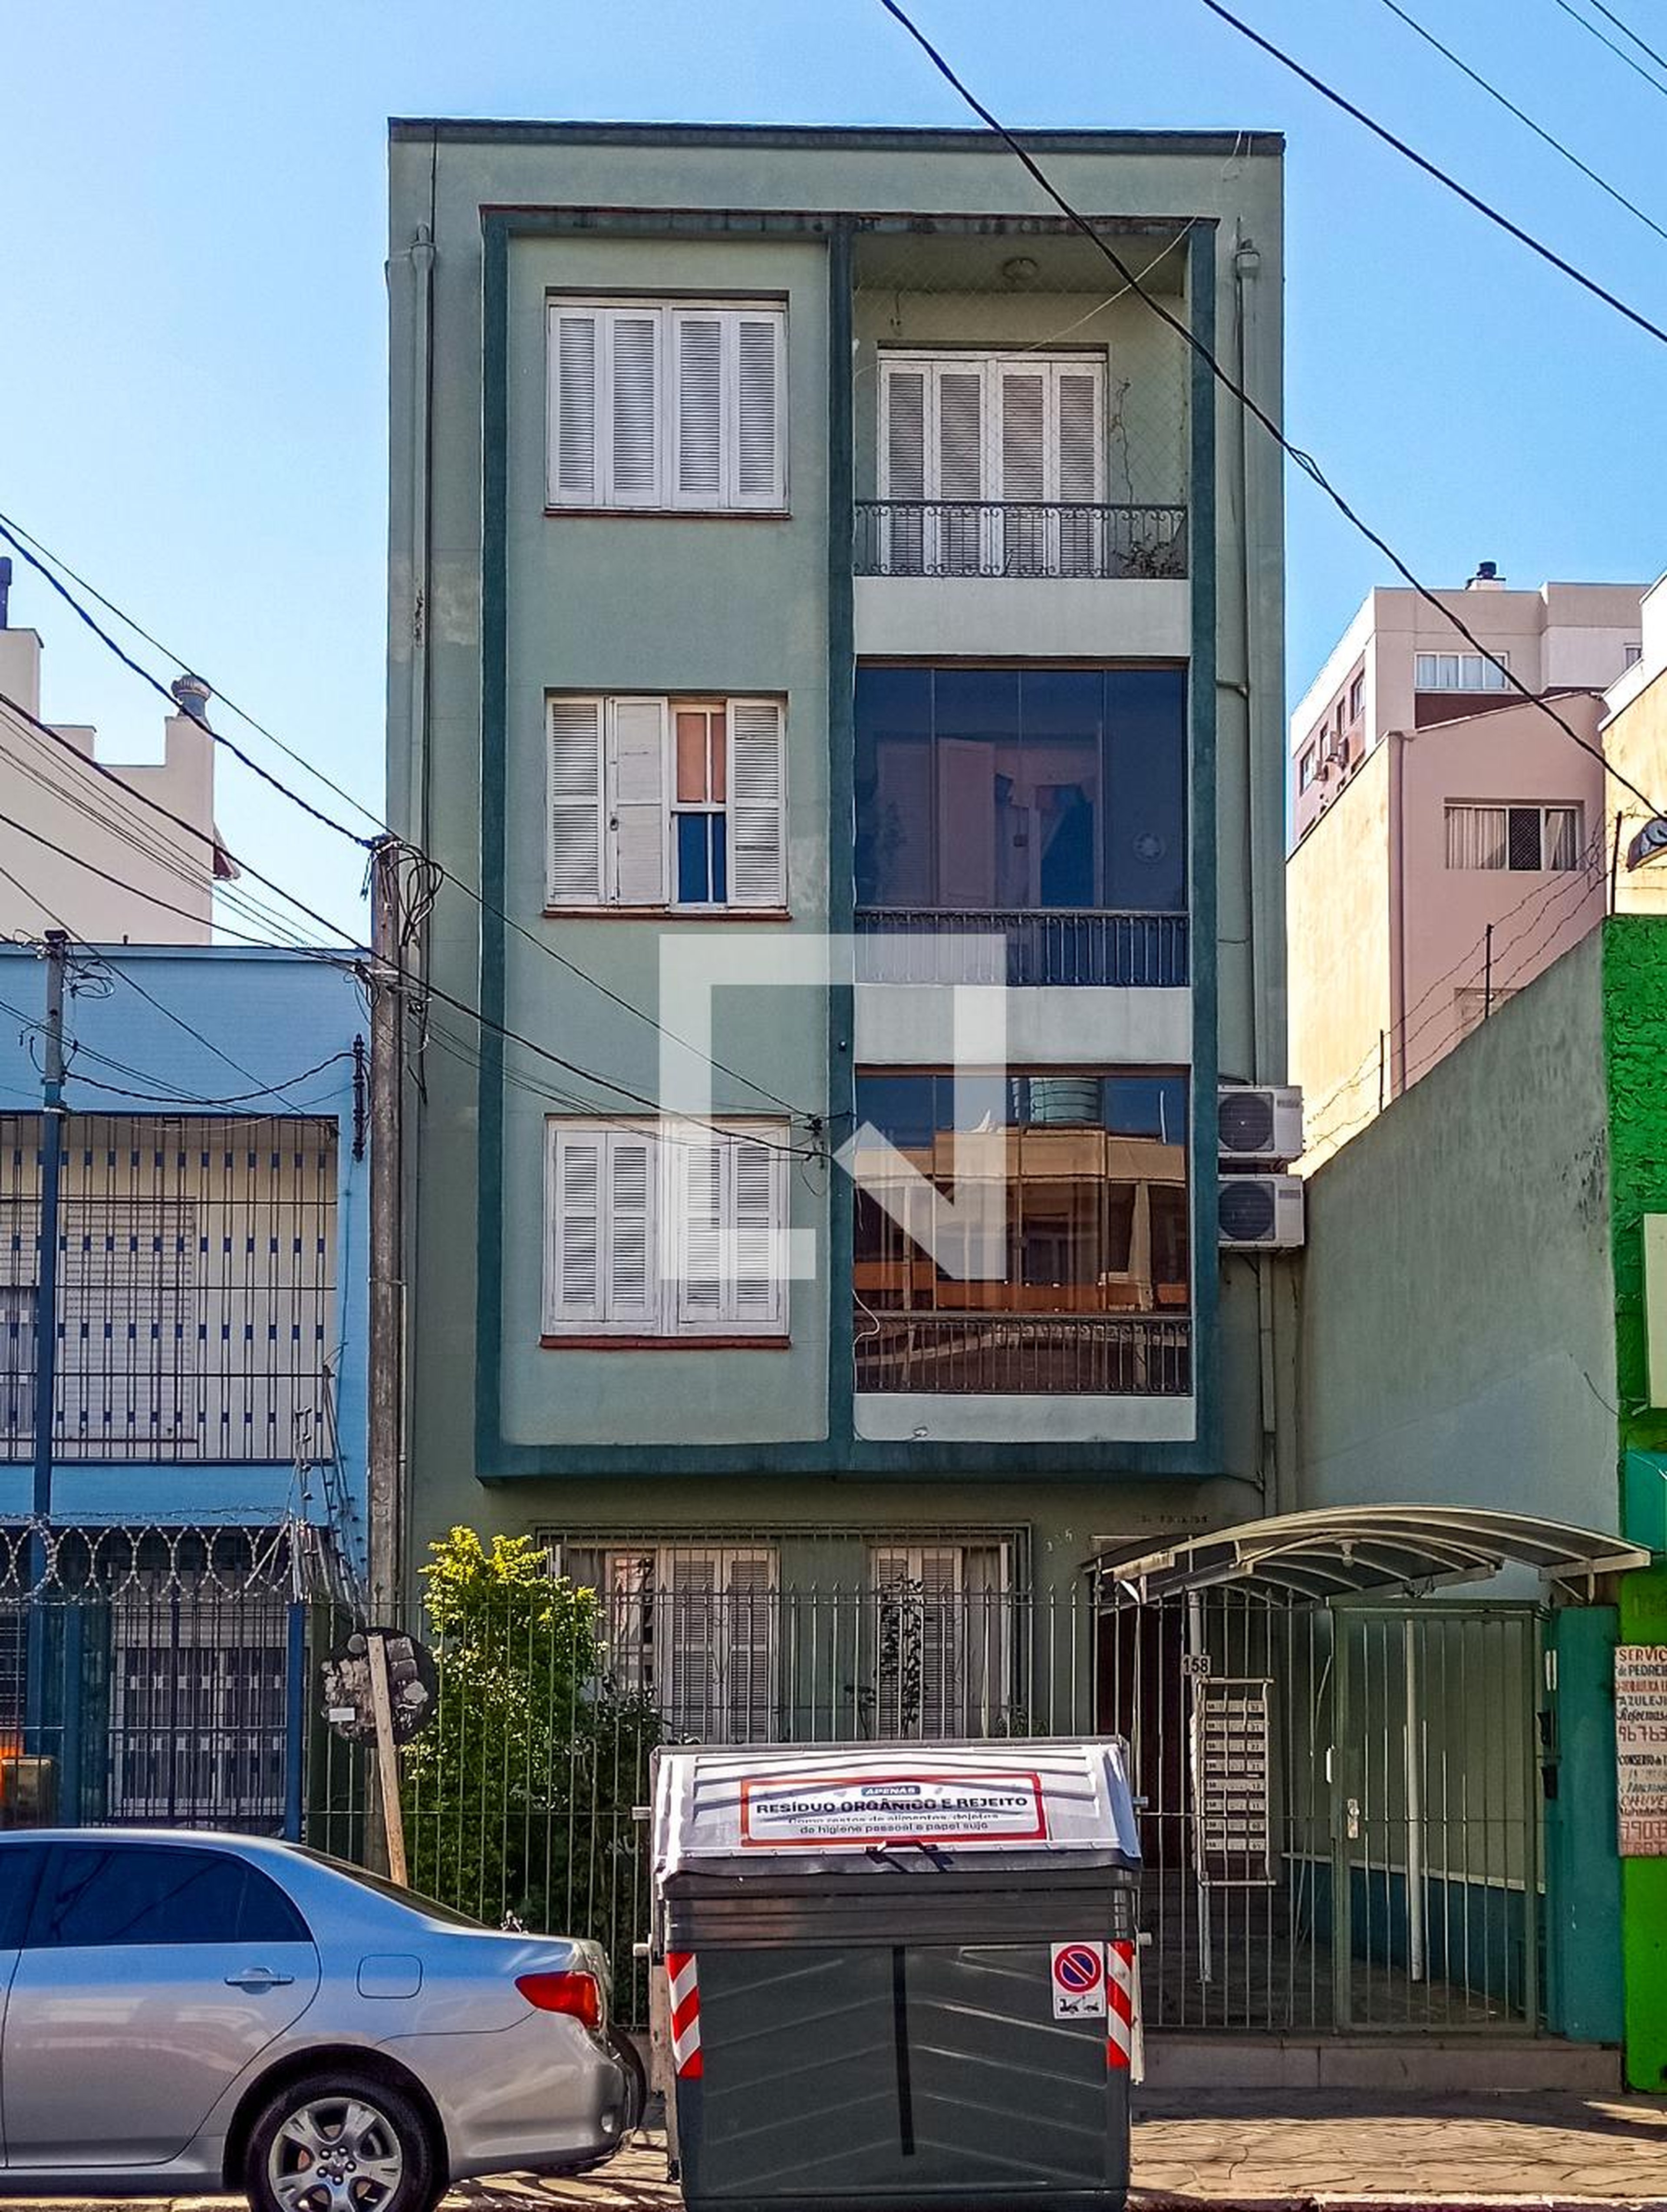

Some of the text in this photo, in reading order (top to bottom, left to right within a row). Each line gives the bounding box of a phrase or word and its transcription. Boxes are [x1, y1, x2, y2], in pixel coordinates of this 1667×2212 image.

[1183, 1658, 1208, 1672] 158
[756, 1797, 1028, 1814] RESÍDUO ORGÂNICO E REJEITO
